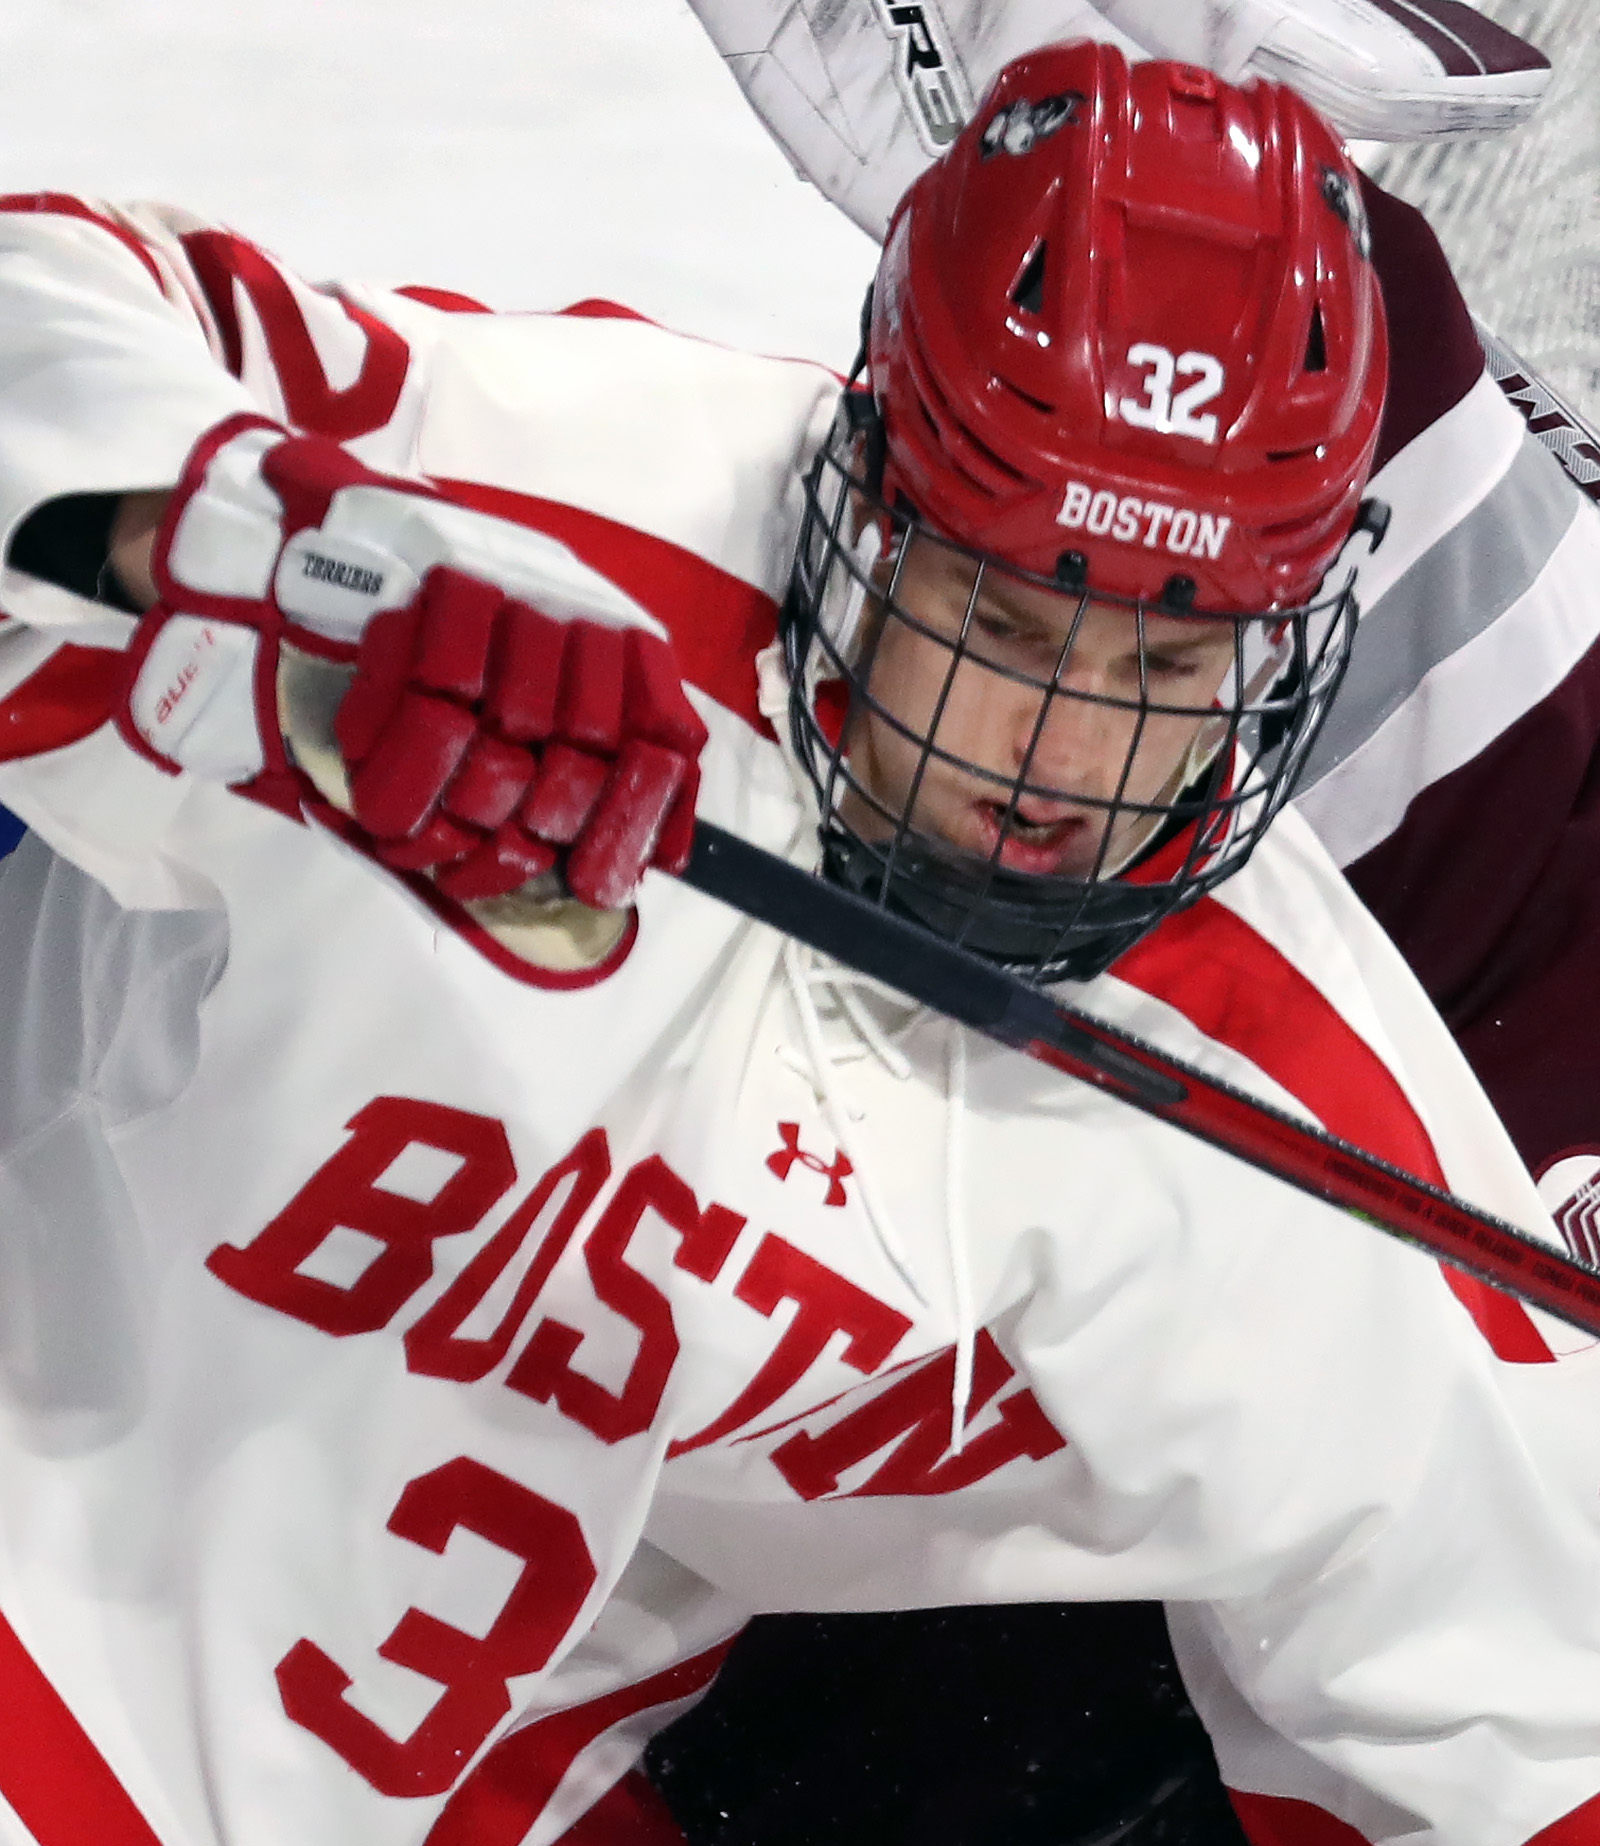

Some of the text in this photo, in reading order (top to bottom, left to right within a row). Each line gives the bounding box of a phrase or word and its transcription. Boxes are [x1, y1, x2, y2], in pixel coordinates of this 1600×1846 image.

[1119, 342, 1224, 438] 32
[1056, 482, 1232, 560] BOSTON
[204, 1093, 1068, 1501] BOSTN
[274, 1455, 597, 1800] 3
